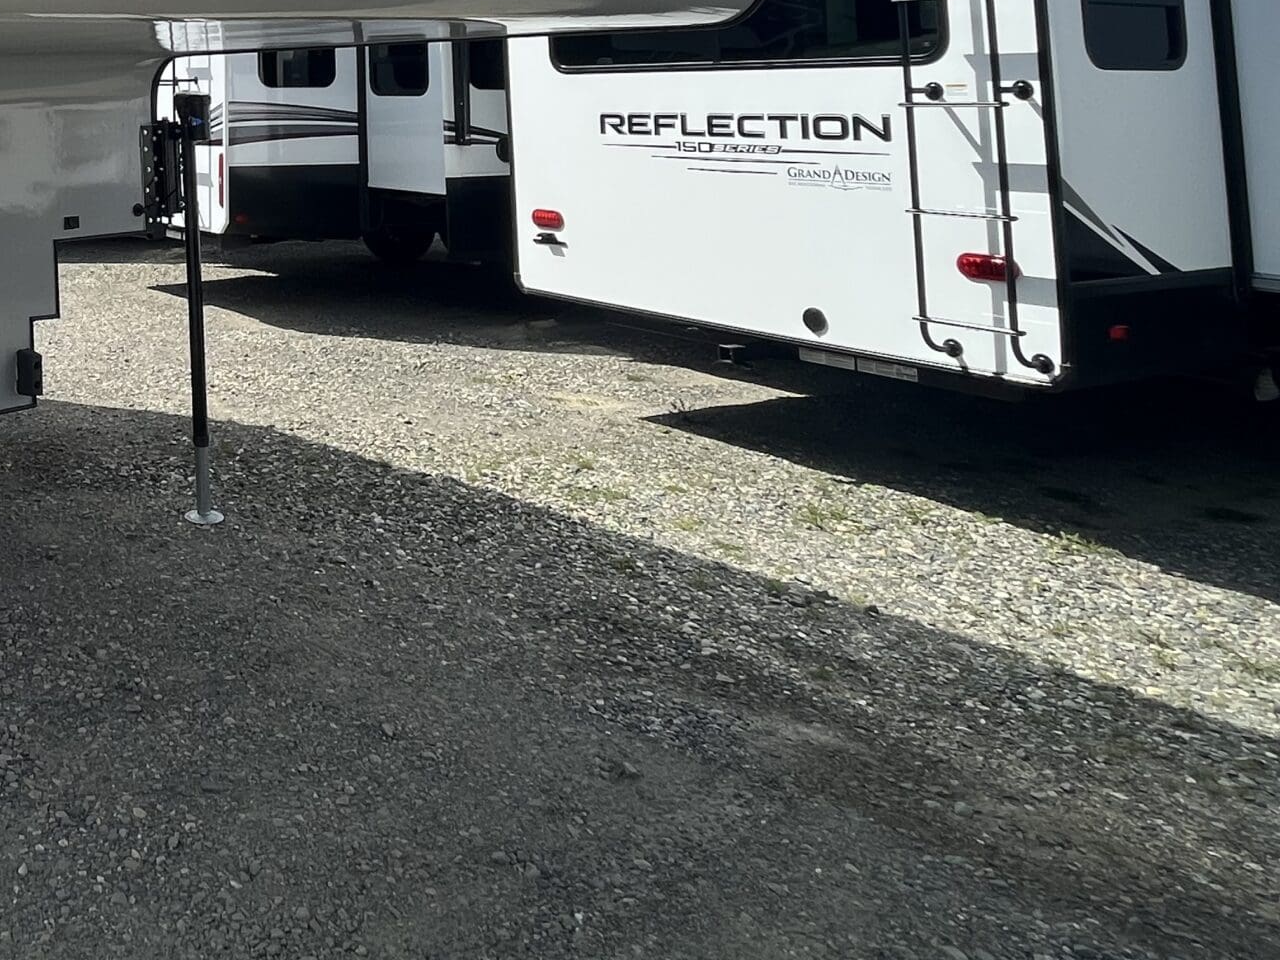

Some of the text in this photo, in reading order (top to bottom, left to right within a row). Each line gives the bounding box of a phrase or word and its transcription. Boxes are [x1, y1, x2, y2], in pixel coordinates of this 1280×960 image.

[600, 112, 892, 142] REFLECTION
[787, 166, 892, 183] GRAND DESIGN
